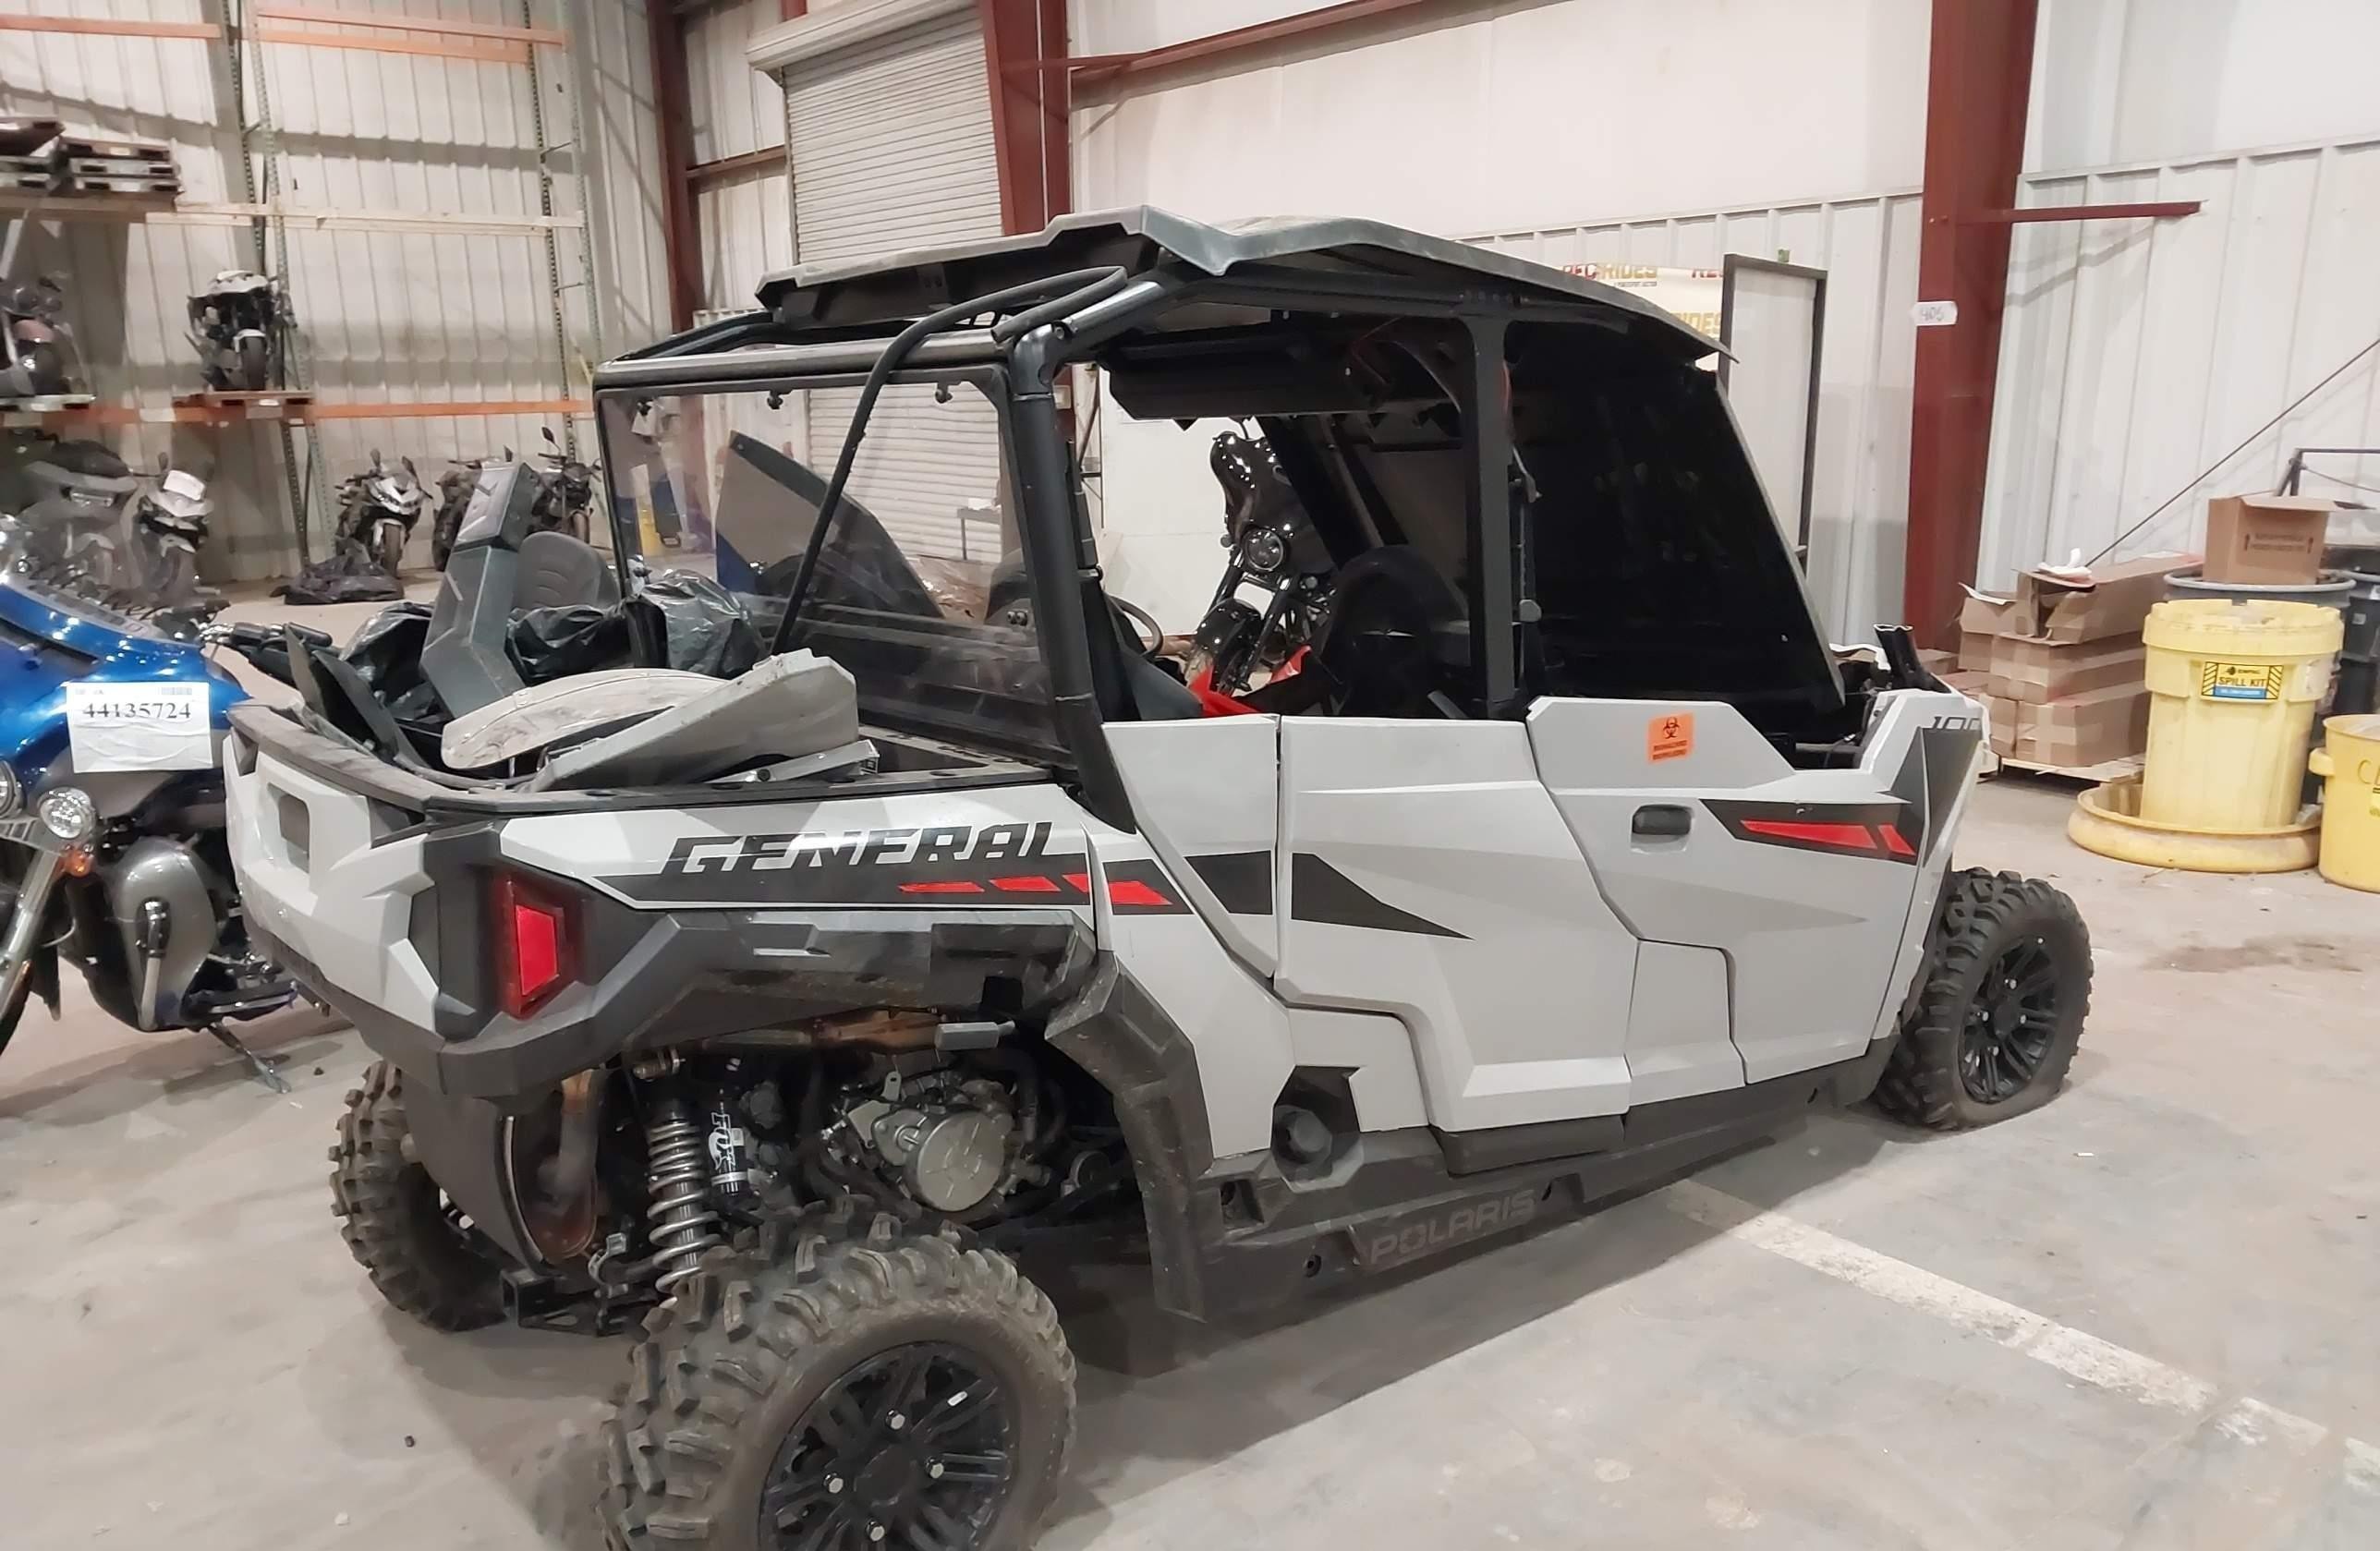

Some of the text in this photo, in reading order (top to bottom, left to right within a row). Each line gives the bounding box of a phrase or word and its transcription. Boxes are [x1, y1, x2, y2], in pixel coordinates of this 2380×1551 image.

[2218, 676, 2267, 687] SPILL KIT
[82, 702, 191, 719] 44135724
[662, 821, 1052, 874] GENERAL
[1370, 1189, 1536, 1264] POLARIS
